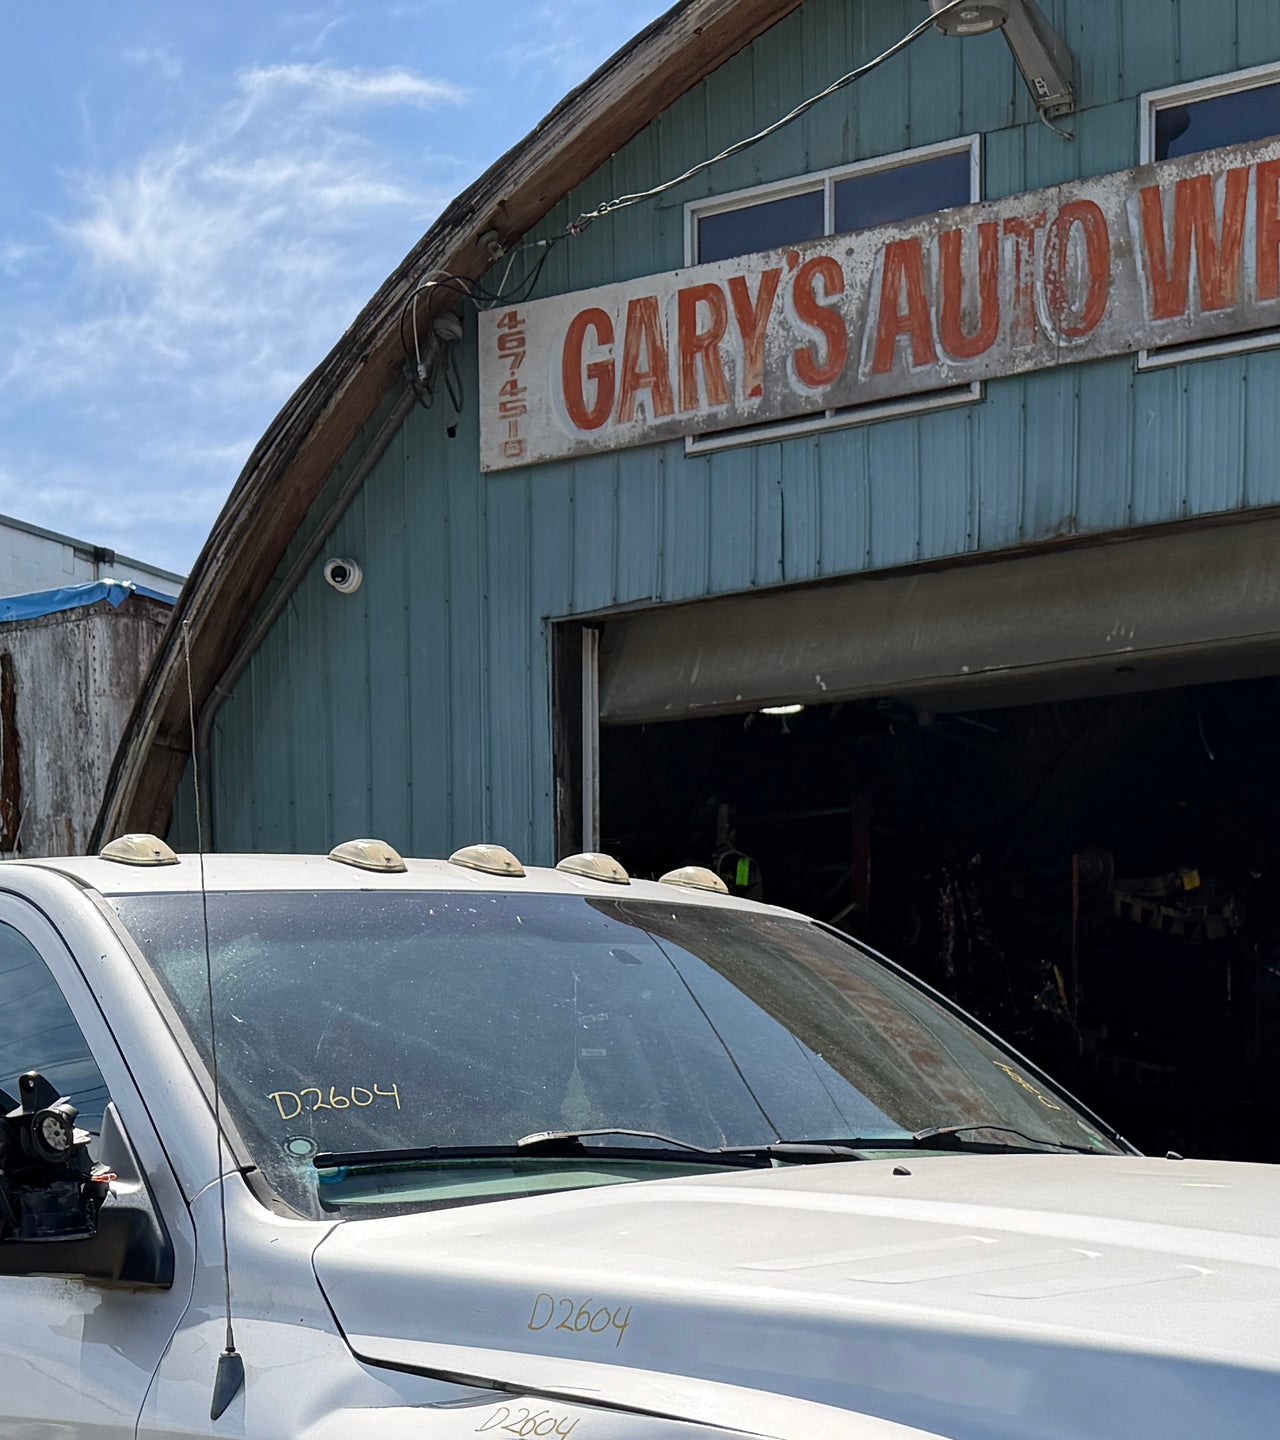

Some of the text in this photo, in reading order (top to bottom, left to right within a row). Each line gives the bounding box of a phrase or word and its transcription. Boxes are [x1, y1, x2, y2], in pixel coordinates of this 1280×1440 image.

[562, 250, 847, 431] GARY'S
[869, 199, 1110, 376] AUTO
[269, 1083, 401, 1120] D2604
[527, 1293, 633, 1348] D2604
